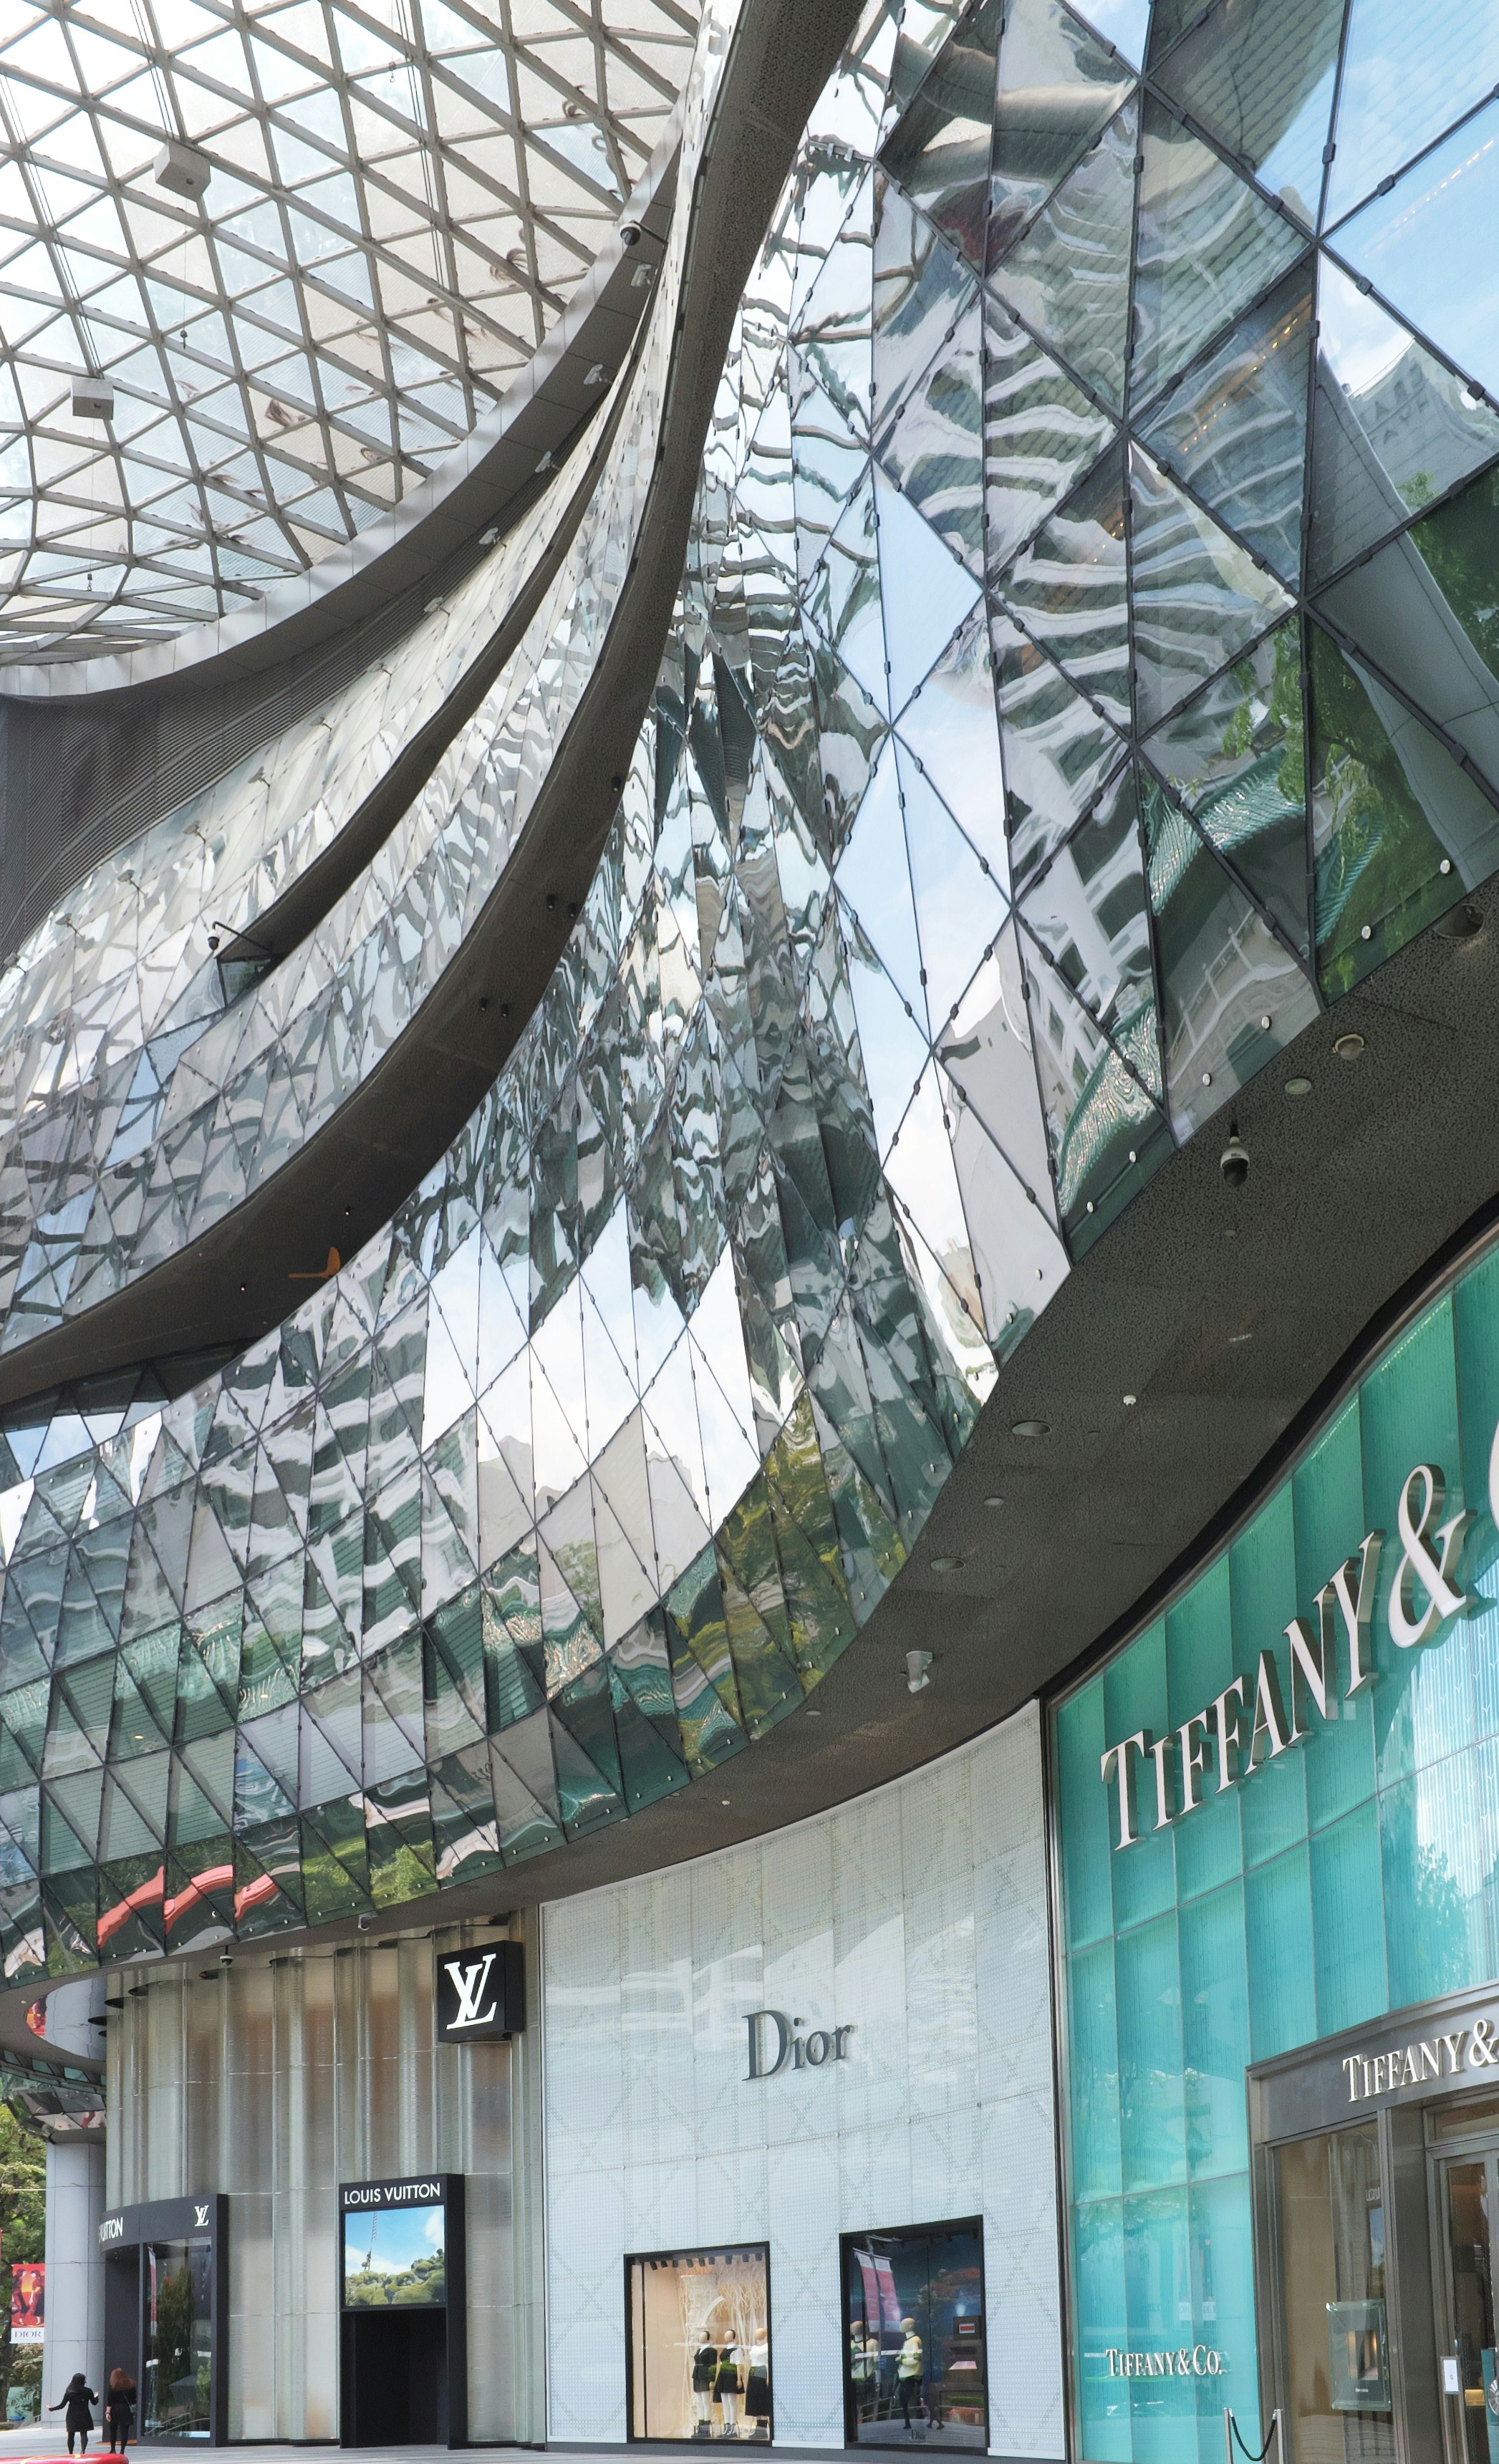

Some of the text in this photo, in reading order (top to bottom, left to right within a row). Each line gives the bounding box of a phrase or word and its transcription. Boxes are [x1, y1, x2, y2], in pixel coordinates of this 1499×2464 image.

[741, 2009, 854, 2082] Dior
[344, 2183, 440, 2205] LOUIS VUITTON
